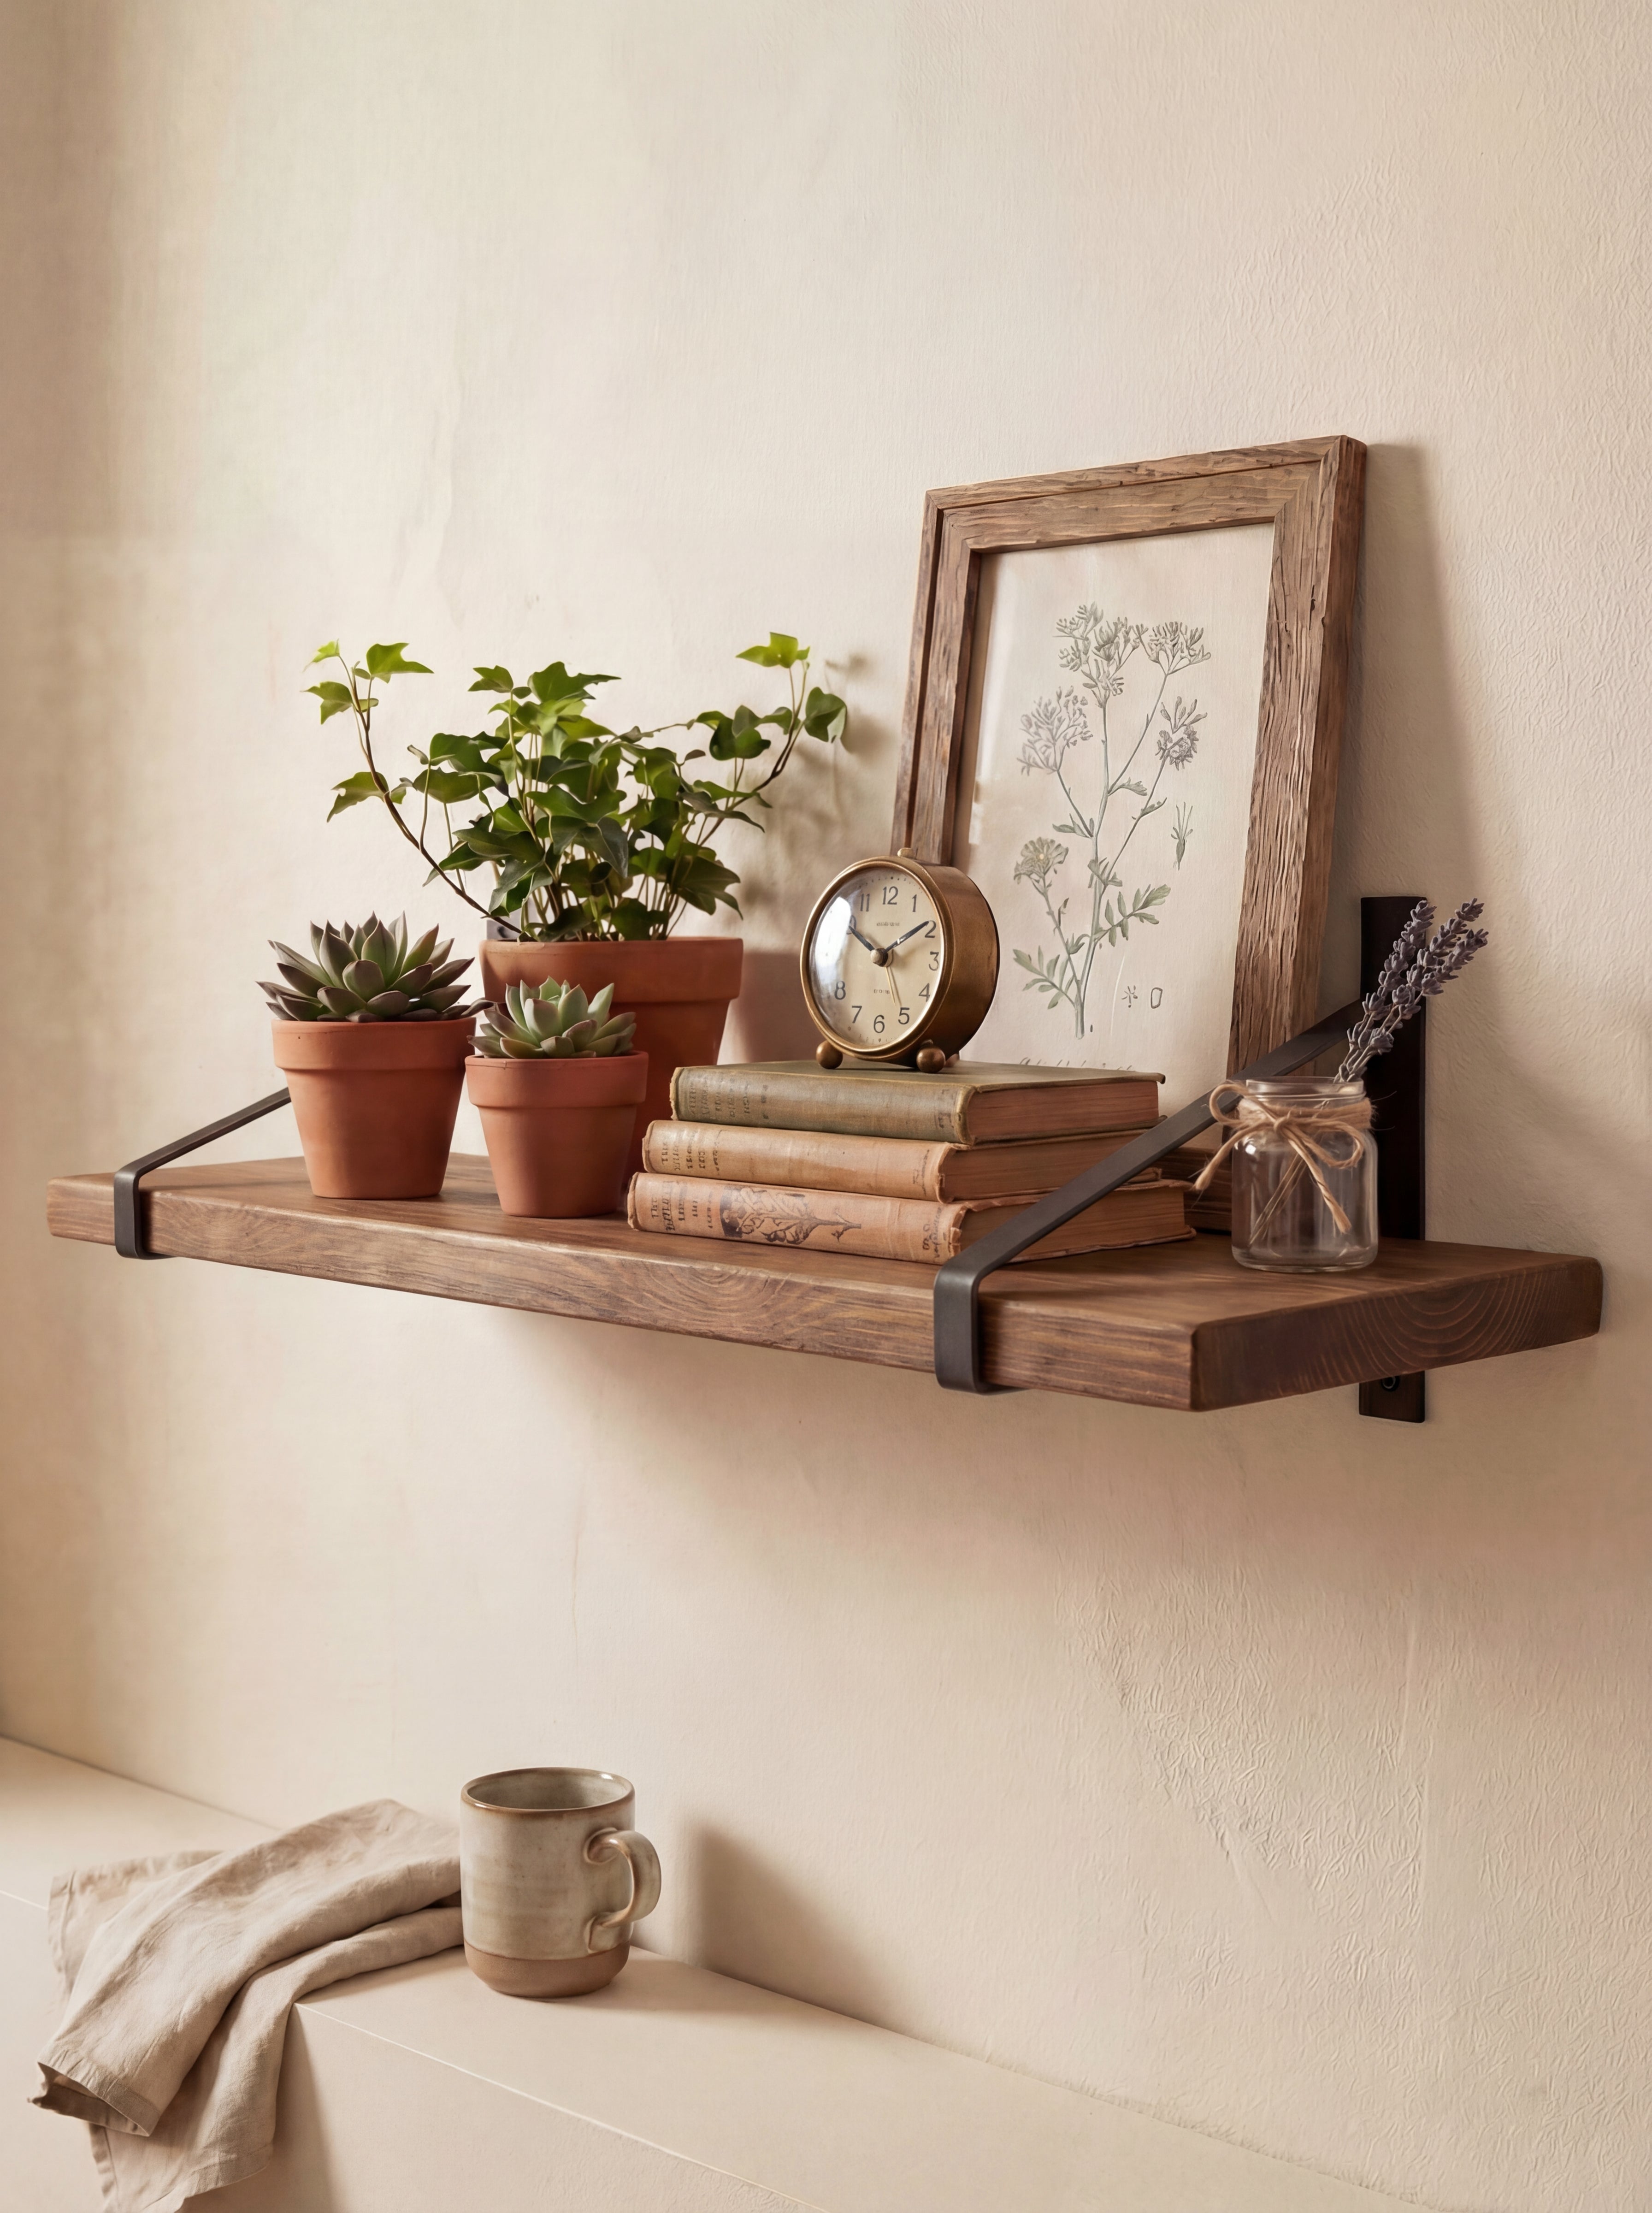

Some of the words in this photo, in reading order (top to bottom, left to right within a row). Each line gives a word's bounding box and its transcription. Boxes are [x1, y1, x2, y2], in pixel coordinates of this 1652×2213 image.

[860, 893, 870, 912] 11
[882, 886, 898, 905] 12
[912, 894, 917, 912] 1
[924, 920, 937, 938] 2
[928, 951, 939, 971] 3
[834, 981, 846, 1000] 8
[919, 983, 931, 1002] 4
[851, 1005, 862, 1024] 7
[898, 1007, 910, 1025] 5
[873, 1015, 885, 1034] 6
